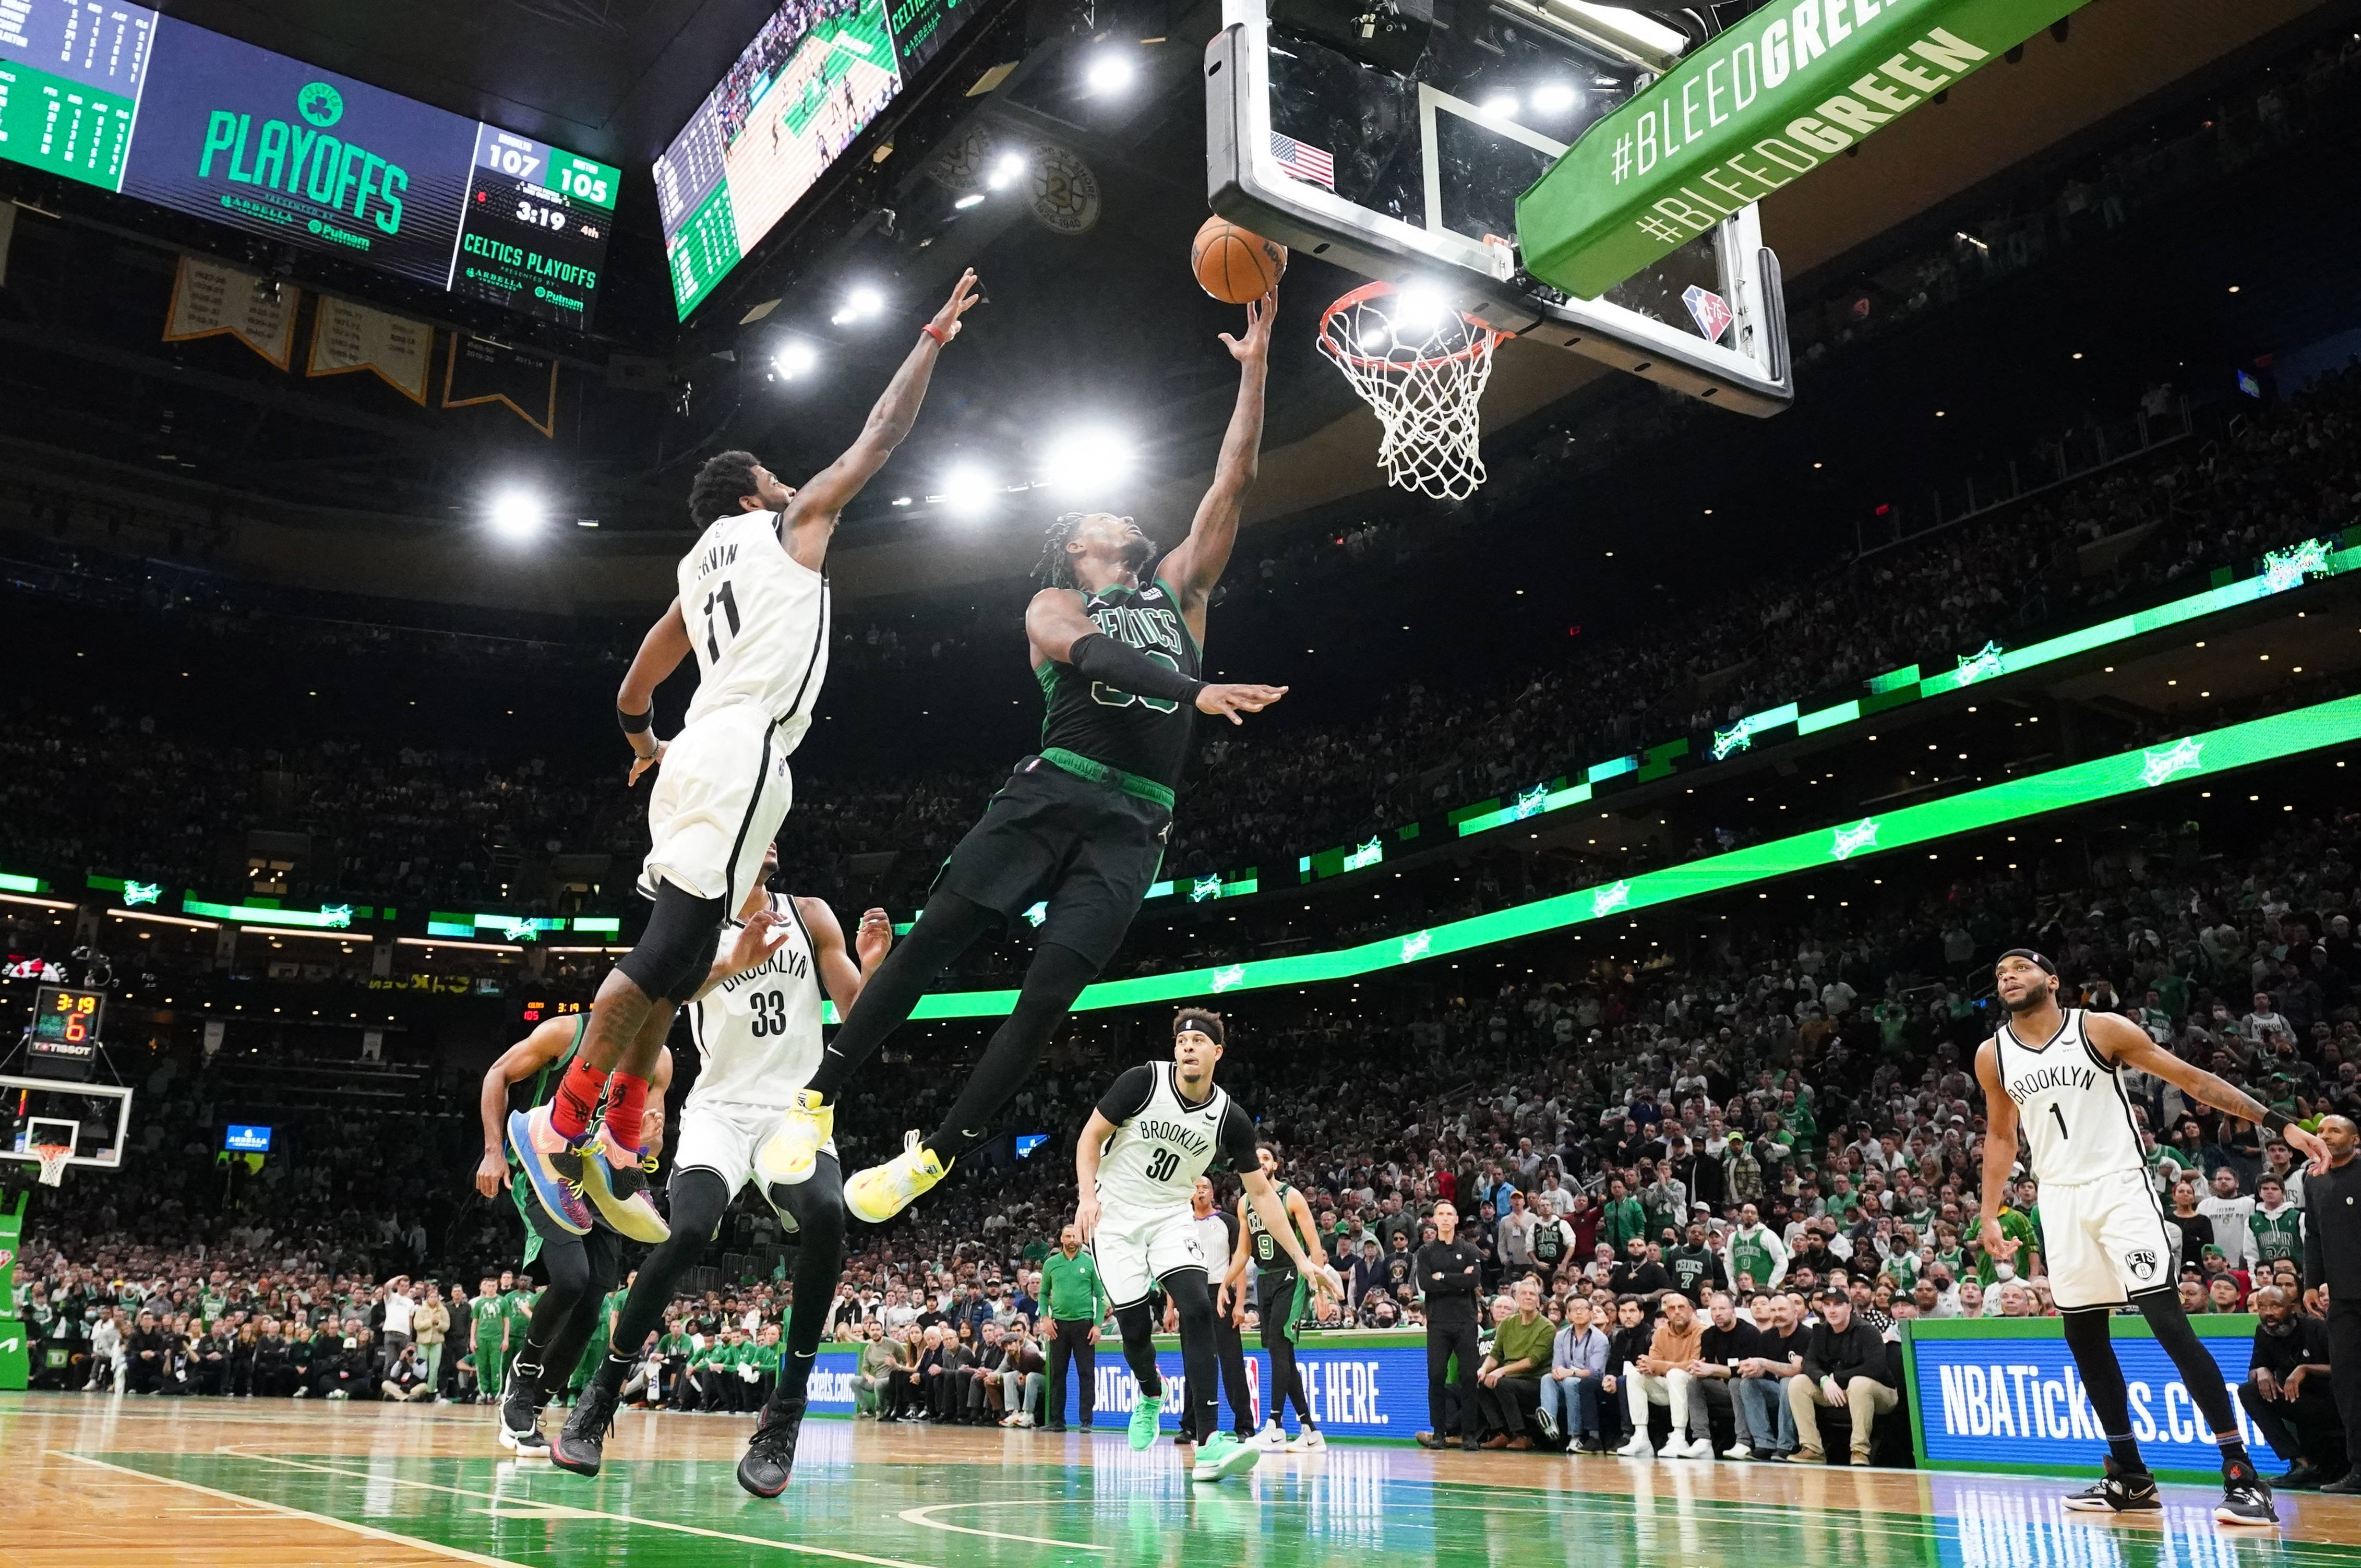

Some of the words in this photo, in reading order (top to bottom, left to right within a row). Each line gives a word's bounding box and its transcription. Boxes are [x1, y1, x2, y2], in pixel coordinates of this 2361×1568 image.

[1636, 27, 1990, 243] #BLEEDGREEN
[198, 110, 409, 235] PLAYOFFS
[490, 144, 541, 177] 107
[561, 168, 607, 202] 105
[516, 201, 566, 231] 3:19
[322, 224, 370, 247] Putnam
[580, 225, 599, 239] 4th
[464, 233, 523, 267] CELTICS
[526, 252, 596, 289] PLAYOFFS
[475, 268, 523, 289] ARBELLA
[546, 290, 584, 309] Putnam
[703, 580, 741, 665] 11
[56, 994, 95, 1014] 3:19
[524, 1010, 539, 1021] 105
[558, 1002, 580, 1013] 3:19
[750, 990, 787, 1038] 33
[65, 1012, 86, 1042] 6
[50, 1043, 92, 1056] TISSOT
[2008, 1066, 2096, 1105] BROOKLYN
[2049, 1103, 2068, 1140] 1
[1141, 1120, 1209, 1157] BROOKLYN
[1145, 1147, 1180, 1182] 30
[1257, 1234, 1274, 1260] 9
[2126, 1251, 2155, 1267] NETS
[1675, 1259, 1704, 1275] CELTICS
[1681, 1272, 1694, 1289] 7
[1325, 1361, 1389, 1424] HERE.
